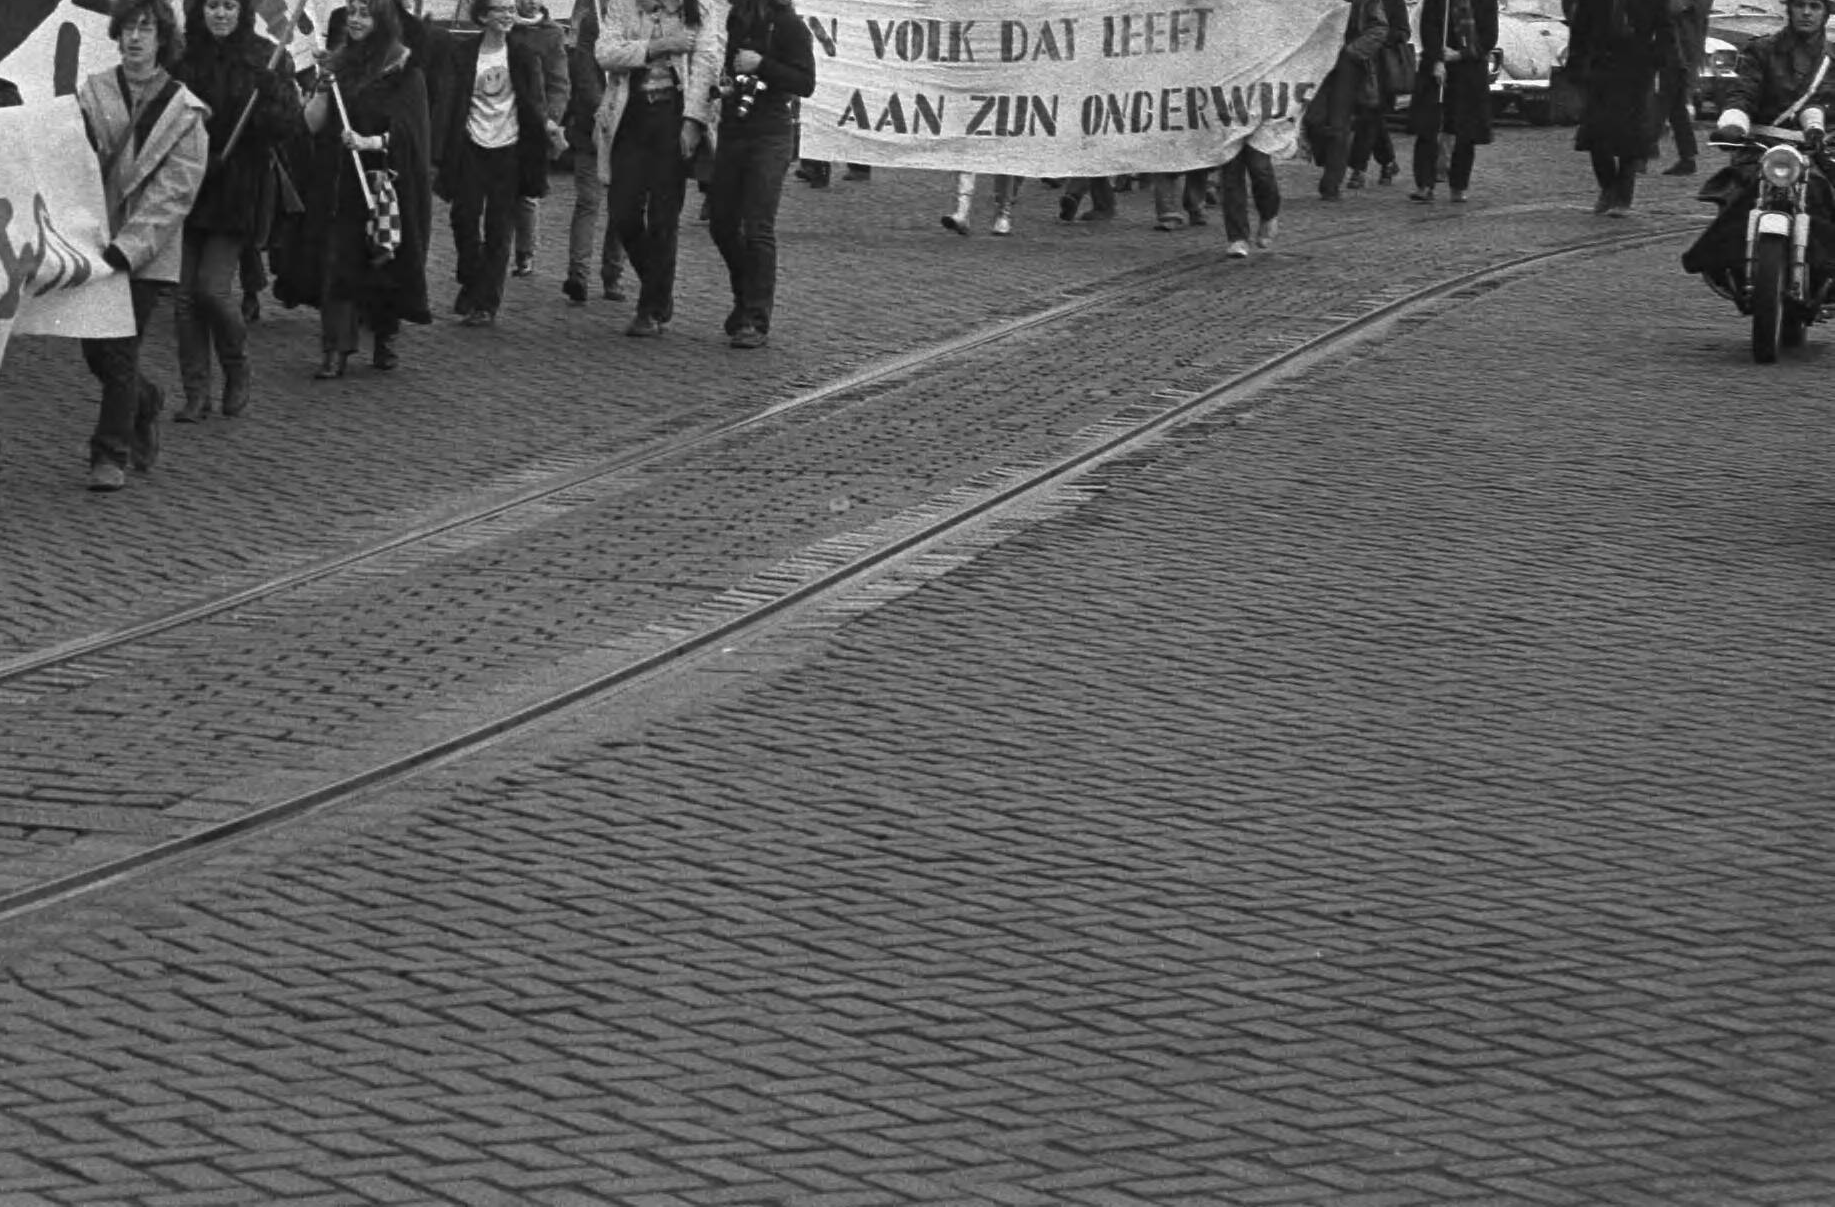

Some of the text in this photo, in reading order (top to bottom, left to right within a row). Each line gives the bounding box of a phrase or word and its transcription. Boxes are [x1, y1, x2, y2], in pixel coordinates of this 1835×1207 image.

[866, 18, 978, 62] VOLK
[1000, 17, 1078, 63] DAT
[1102, 8, 1214, 59] LEEFT
[837, 89, 945, 136] AAN
[966, 94, 1060, 138] ZIJN
